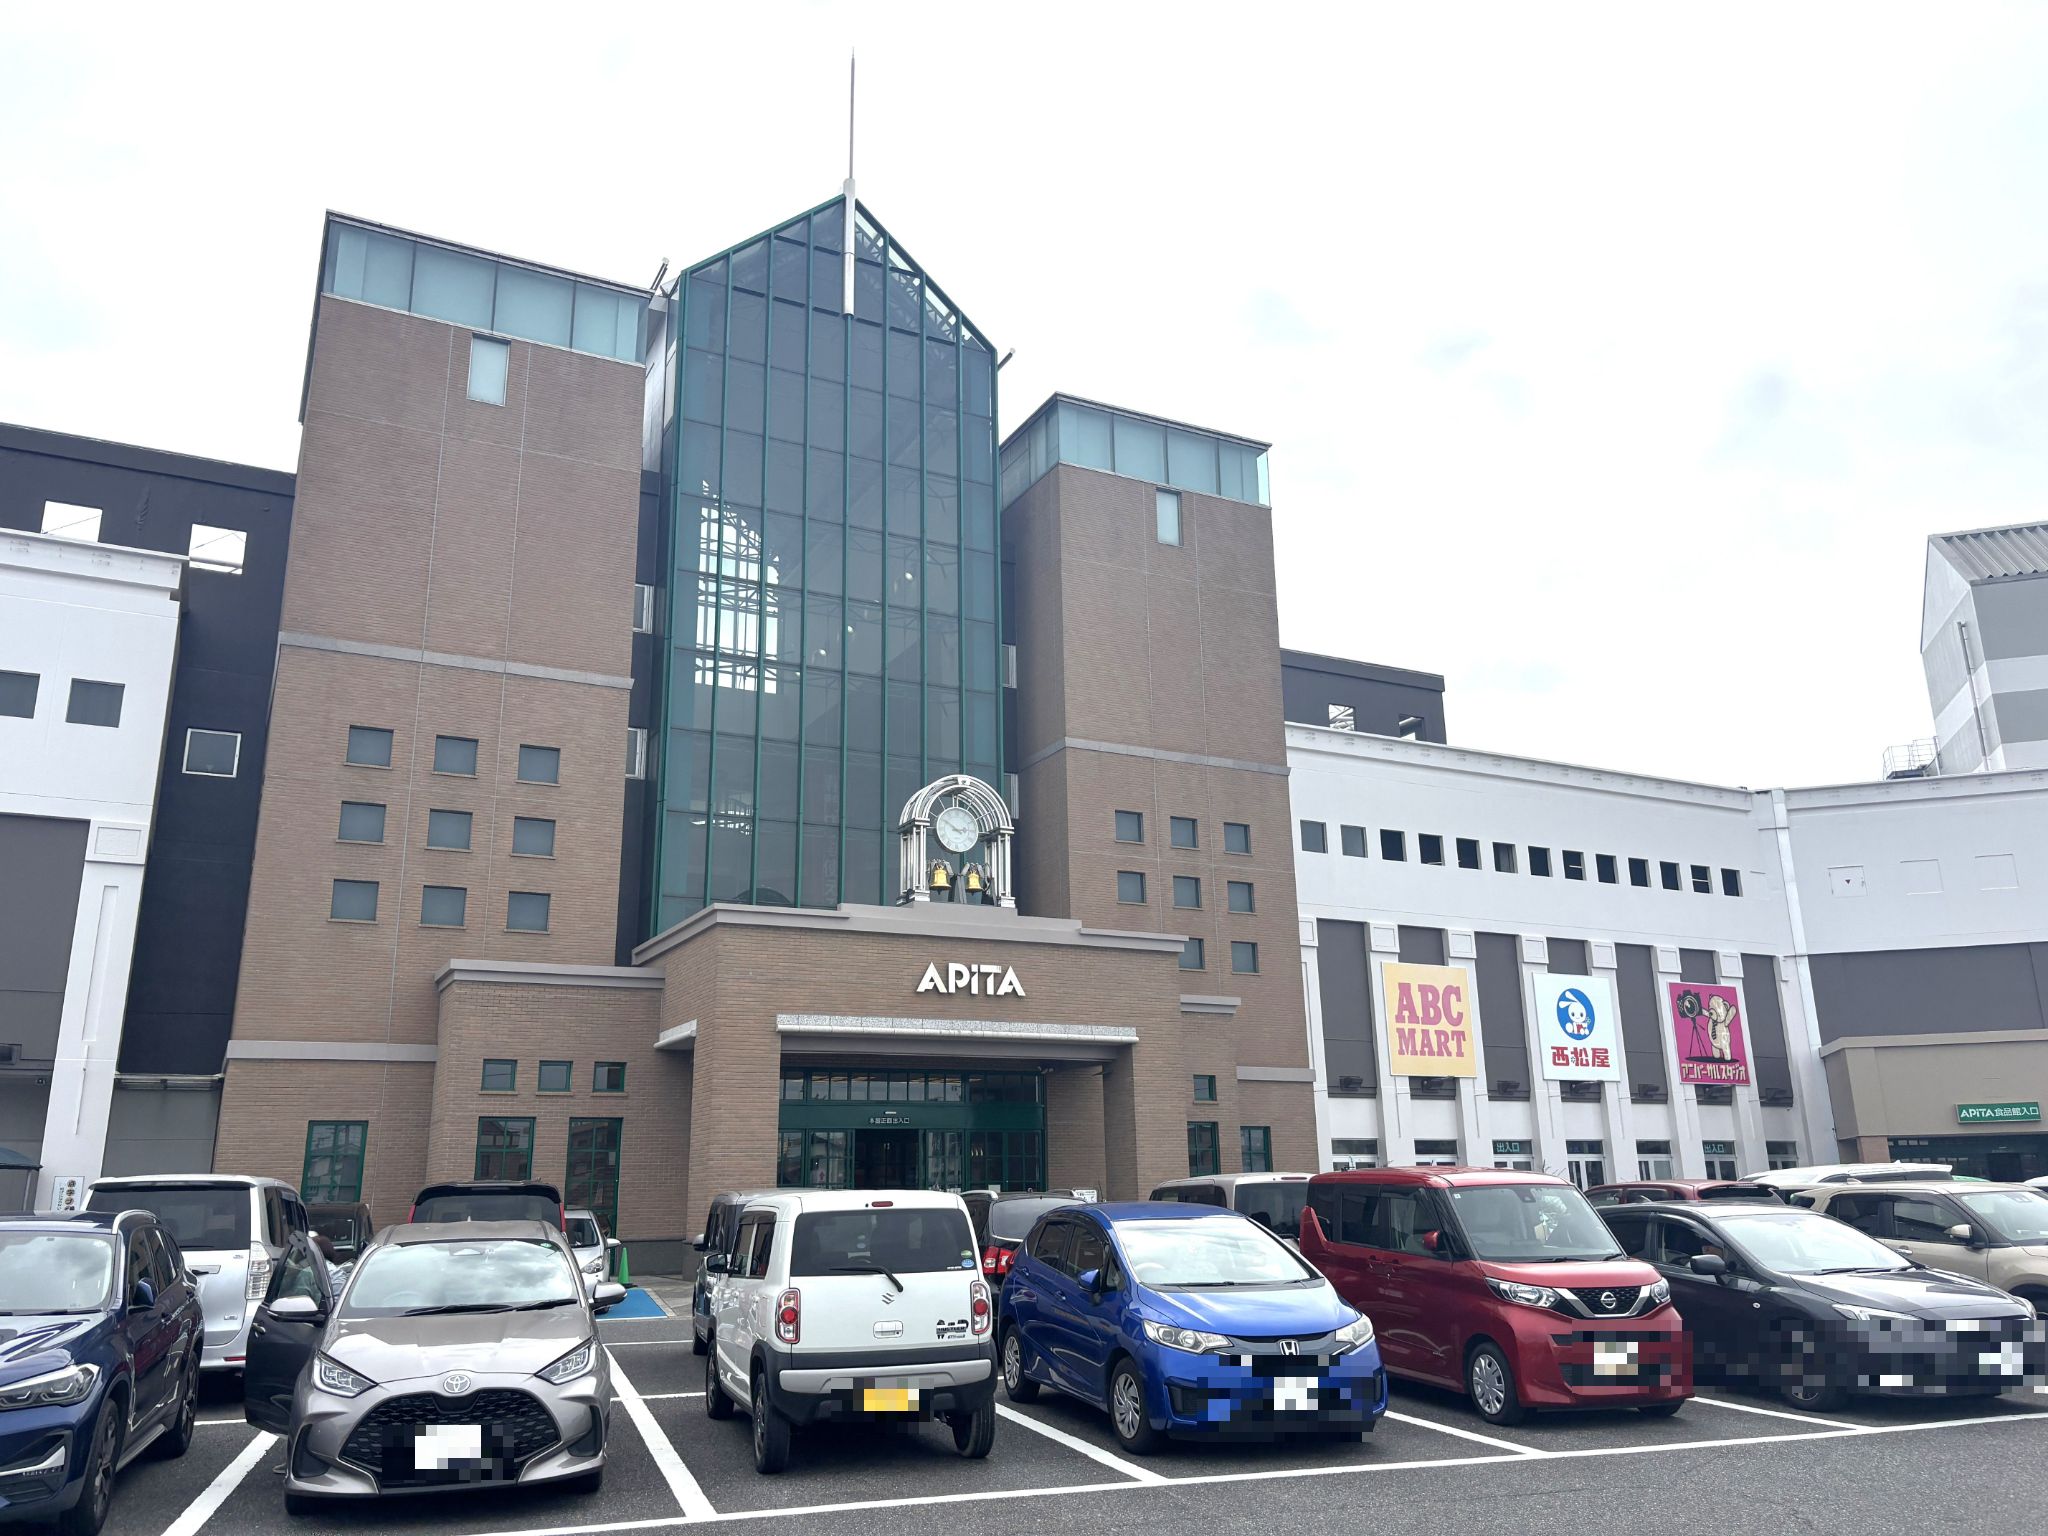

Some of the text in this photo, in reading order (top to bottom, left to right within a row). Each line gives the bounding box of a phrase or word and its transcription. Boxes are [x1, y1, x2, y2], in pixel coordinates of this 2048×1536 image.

[1395, 982, 1464, 1027] ABC
[1396, 1027, 1467, 1058] MART
[1550, 1046, 1611, 1068] 西松屋
[1681, 1063, 1746, 1081] アニバーサルスタジオ
[1496, 1142, 1520, 1153] 出入口
[1704, 1143, 1725, 1153] 出入口
